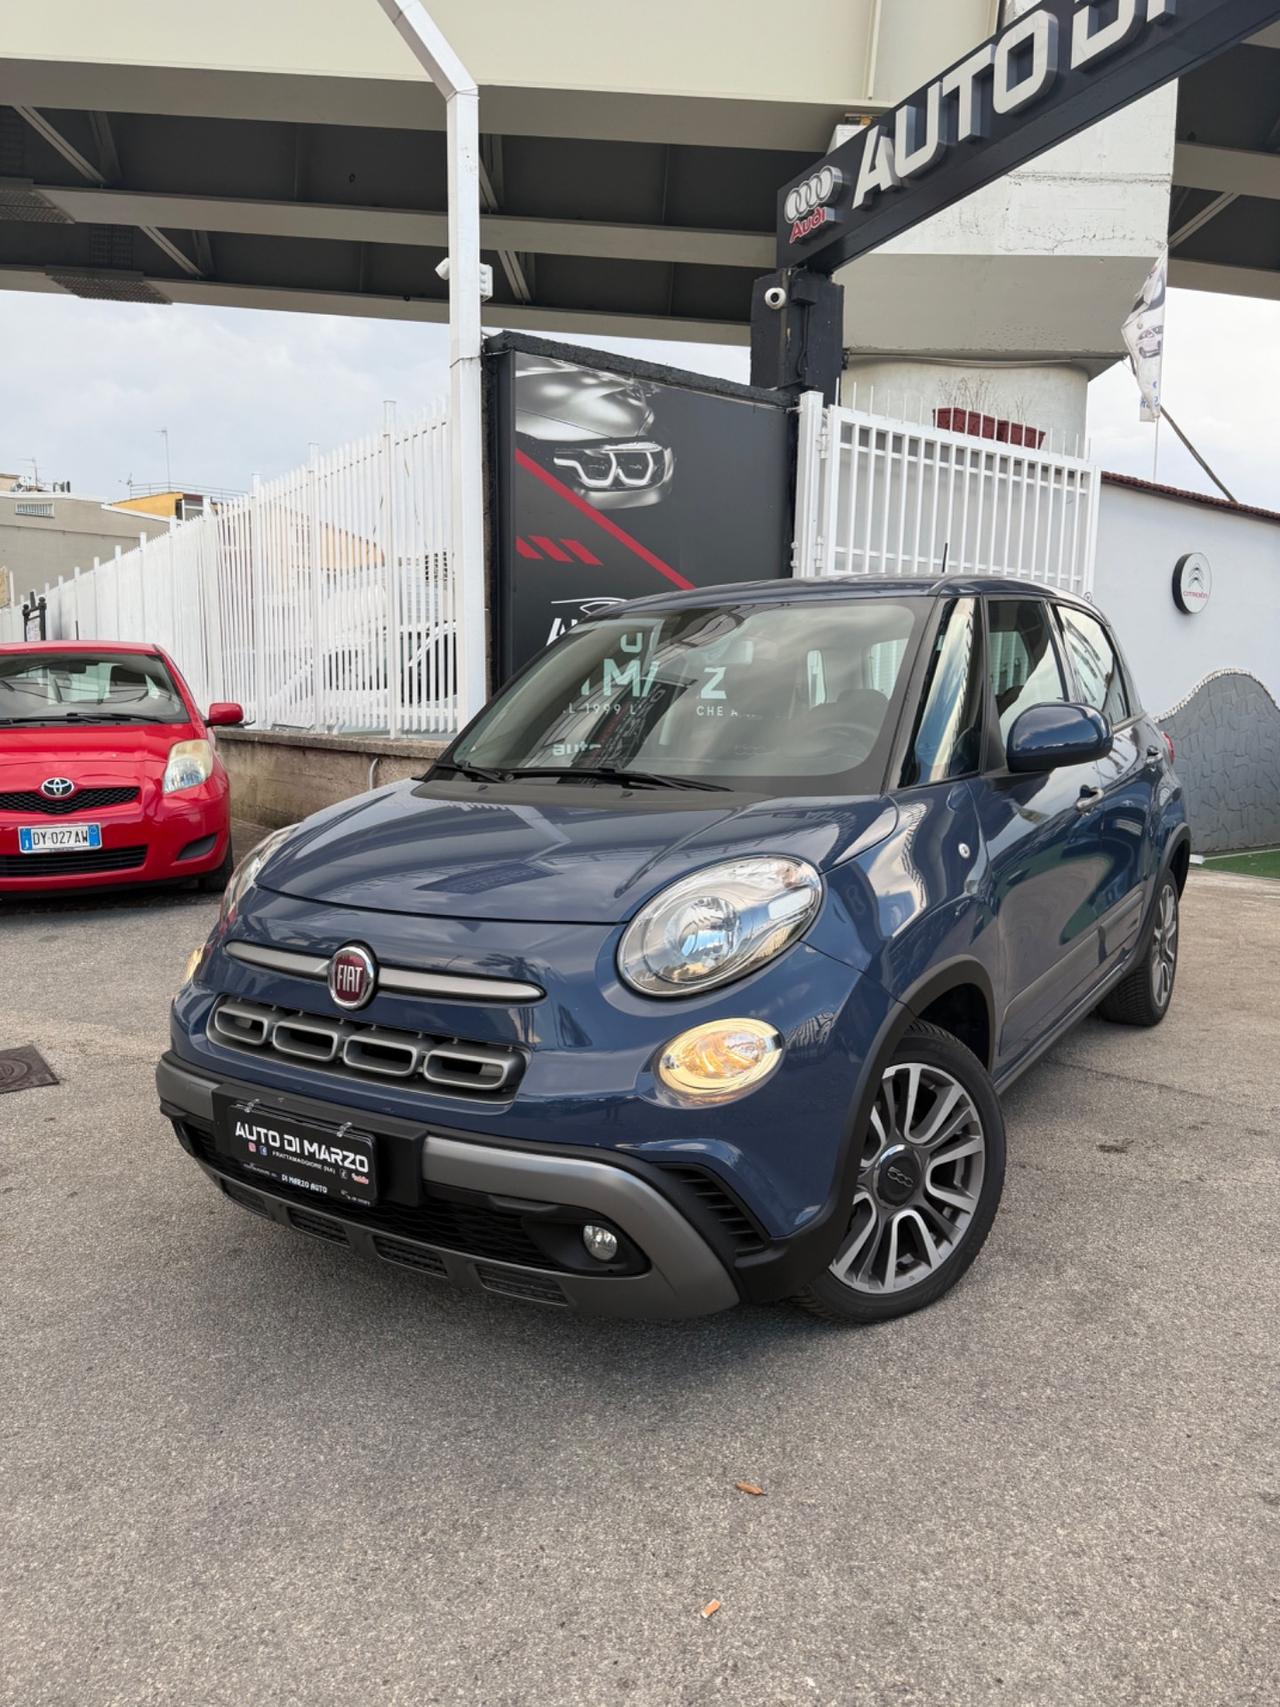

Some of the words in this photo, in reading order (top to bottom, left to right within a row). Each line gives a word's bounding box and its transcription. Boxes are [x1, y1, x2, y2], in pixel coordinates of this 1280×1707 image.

[852, 9, 1056, 210] AUTO
[788, 206, 829, 244] Audi
[585, 702, 622, 715] 1999
[696, 705, 724, 717] CHE
[336, 964, 363, 993] FIAT
[235, 1121, 280, 1148] AUTO
[283, 1134, 300, 1153] DI
[303, 1139, 369, 1173] MARZO
